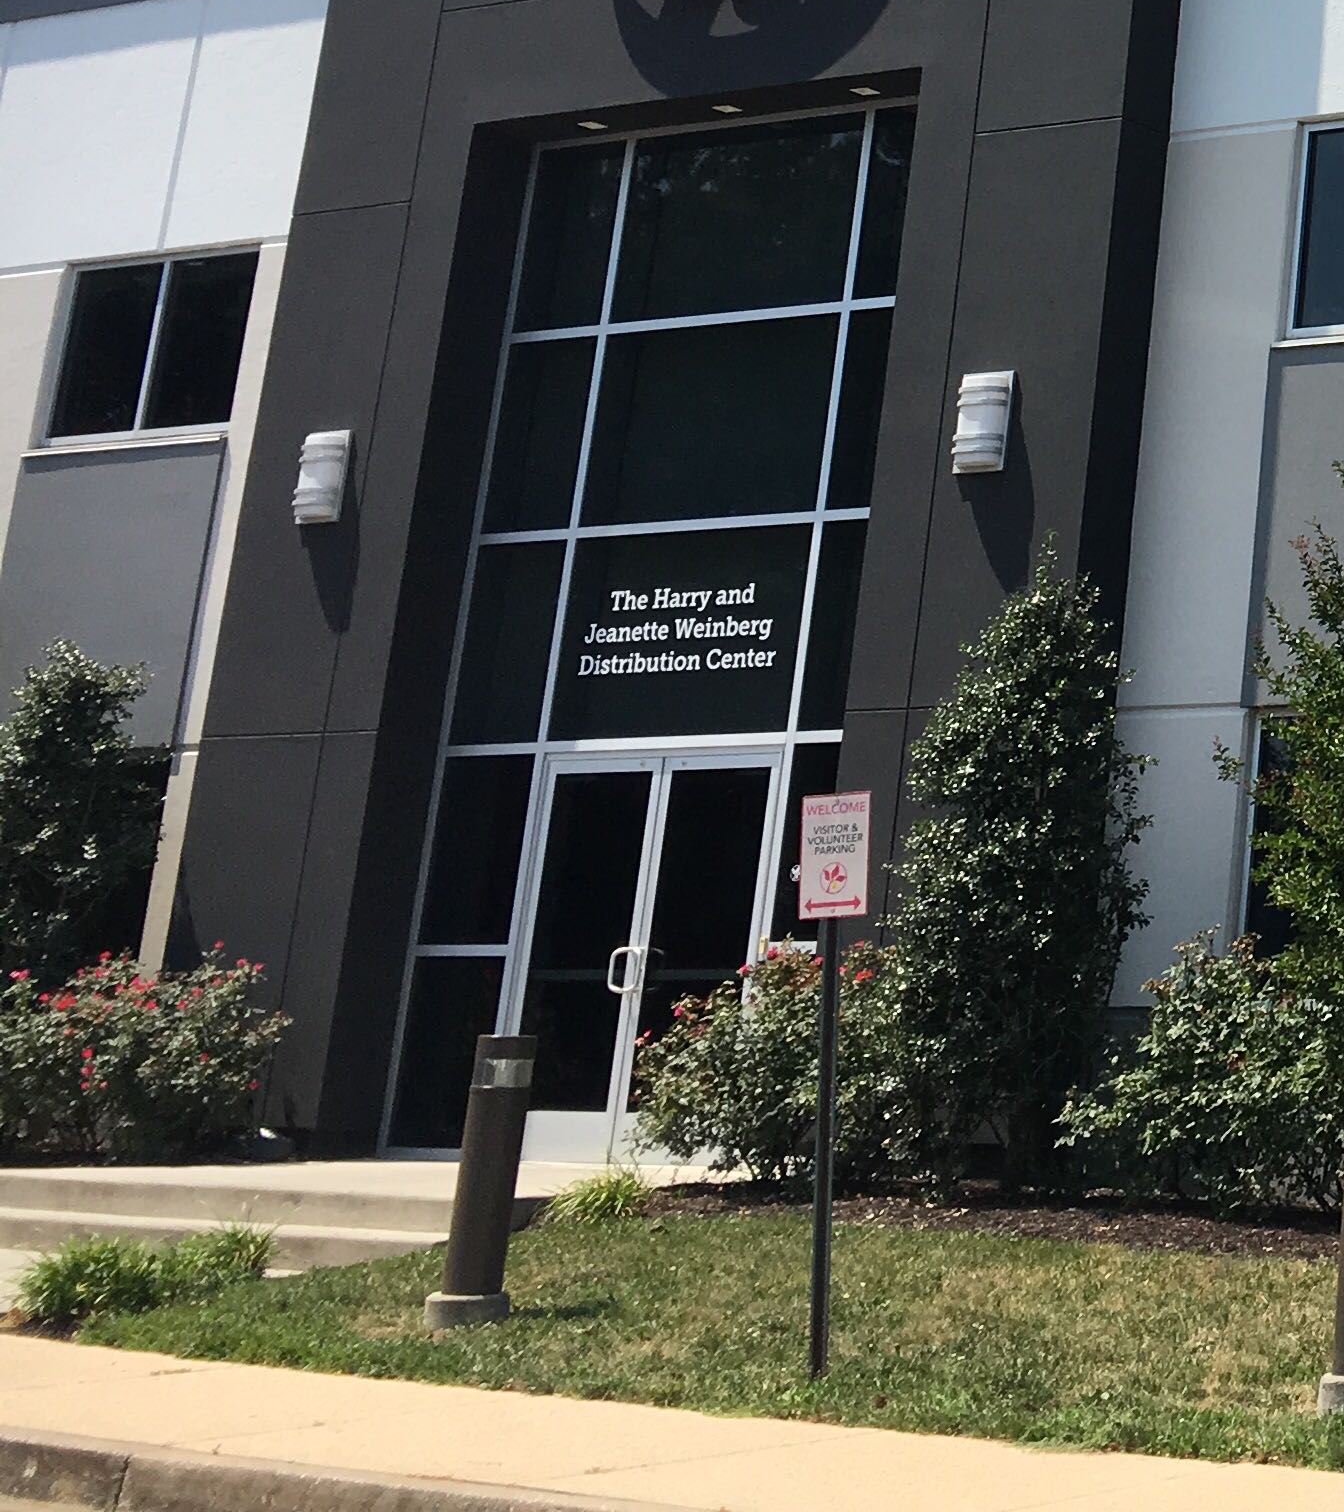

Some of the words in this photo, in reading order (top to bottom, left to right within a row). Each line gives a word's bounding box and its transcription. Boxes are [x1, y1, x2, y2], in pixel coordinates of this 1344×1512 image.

[610, 590, 649, 611] The
[652, 587, 713, 612] Harry
[715, 583, 756, 605] and
[584, 623, 670, 644] Jeanette
[674, 615, 774, 640] Weinberg
[577, 651, 701, 676] Distribution
[705, 648, 777, 670] Center
[806, 801, 866, 816] WELCOME
[813, 824, 849, 835] VISITOR
[851, 823, 858, 832] &
[807, 833, 863, 846] VOLUNTEER
[814, 844, 856, 855] PARKING
